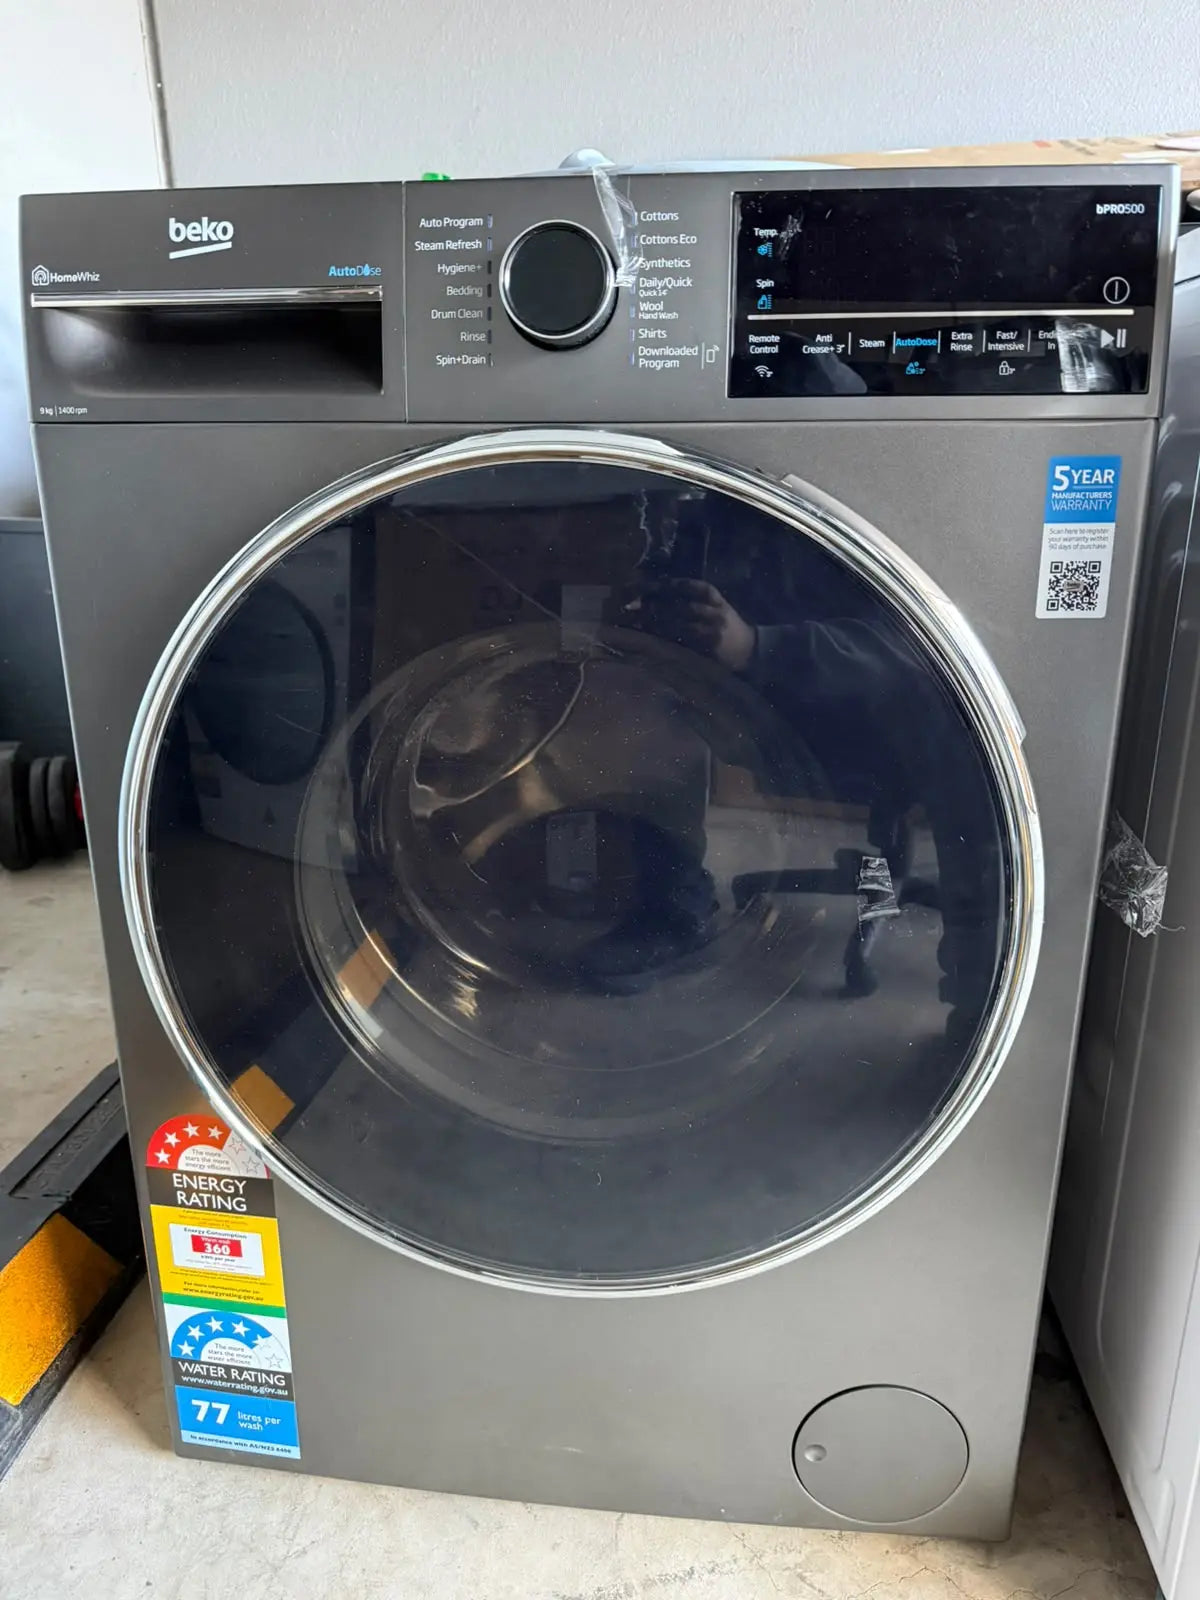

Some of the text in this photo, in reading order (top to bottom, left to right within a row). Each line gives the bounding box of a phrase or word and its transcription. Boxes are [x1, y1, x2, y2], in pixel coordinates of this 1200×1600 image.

[1096, 204, 1145, 214] bPRO500
[640, 211, 679, 221] Cottons
[419, 217, 483, 229] Auto Program
[169, 217, 234, 243] beko
[754, 227, 778, 237] Temp.
[640, 234, 697, 244] Cottons Eco
[415, 240, 482, 251] Steam Refresh
[640, 257, 691, 270] Synthetics
[328, 264, 382, 277] AutoDose
[437, 264, 482, 275] Hygiene+
[50, 271, 100, 284] HomeWhiz
[640, 277, 693, 289] Daily/Quick
[756, 279, 774, 288] Spin
[446, 286, 483, 297] Bedding
[640, 301, 663, 311] Wool
[431, 309, 483, 319] Drum Clean
[460, 332, 486, 341] Rinse
[638, 328, 667, 338] Shirts
[815, 334, 833, 342] Anti
[951, 331, 973, 341] Extra
[996, 331, 1018, 341] Fast/
[749, 334, 780, 343] Remote
[859, 339, 885, 348] Steam
[895, 338, 937, 346] AutoDose
[639, 346, 699, 355] Downloaded
[750, 345, 779, 354] Control
[802, 345, 835, 354] Crease+
[950, 343, 973, 351] Rinse
[988, 342, 1024, 350] Intensive
[1048, 342, 1056, 350] In
[436, 355, 486, 367] Spin+Drain
[639, 358, 680, 370] Program
[40, 406, 45, 415] 9
[45, 406, 54, 416] kg
[75, 407, 88, 416] rpm
[1053, 465, 1115, 491] 5 YEAR
[1051, 500, 1112, 511] WARRANTY
[172, 1173, 247, 1195] ENERGY
[177, 1191, 247, 1212] RATING
[184, 1227, 248, 1239] Energy Consumption
[204, 1243, 231, 1255] 360
[178, 1361, 286, 1386] WATER RATING
[182, 1375, 288, 1395] www.waterrating.gov.au
[191, 1399, 230, 1424] 77
[237, 1411, 281, 1425] litres per
[239, 1421, 263, 1431] wash
